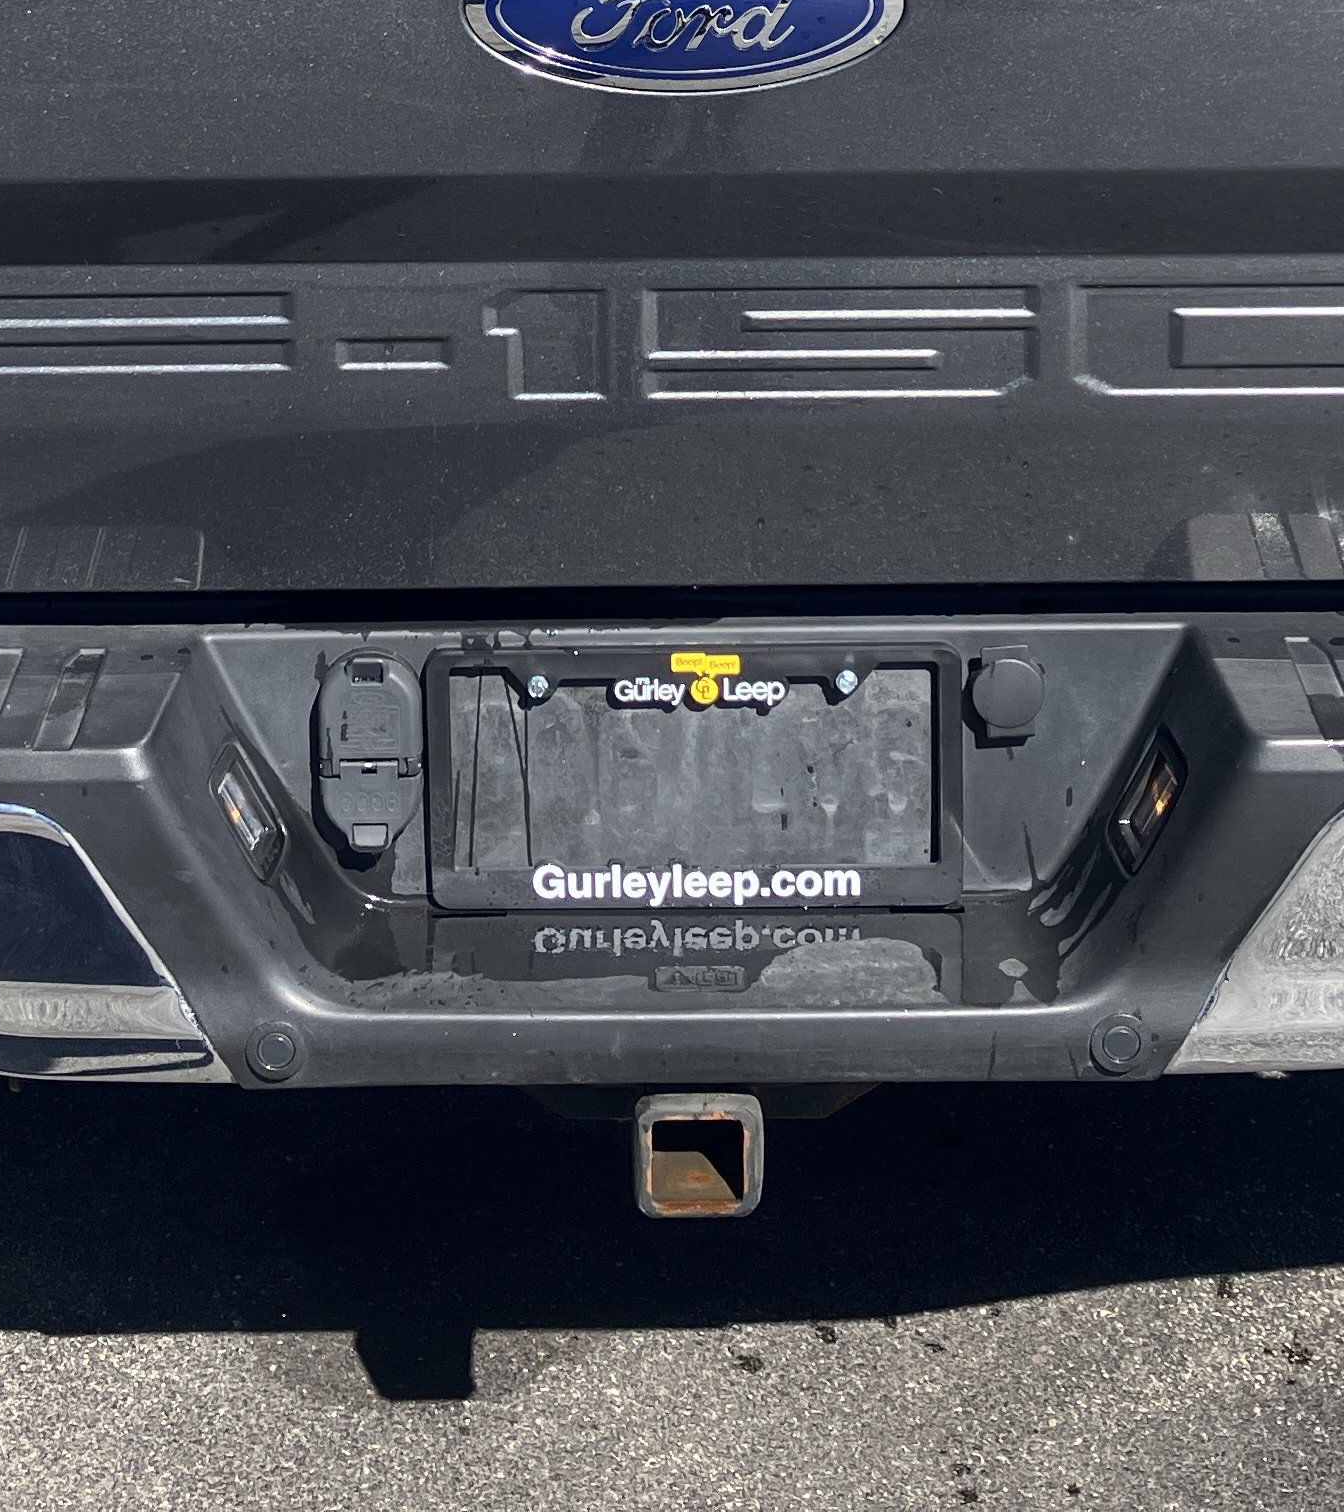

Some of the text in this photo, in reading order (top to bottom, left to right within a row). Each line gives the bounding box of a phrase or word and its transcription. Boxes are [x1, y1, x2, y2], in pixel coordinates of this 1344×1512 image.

[676, 657, 736, 671] Beep! Beep!
[614, 678, 685, 706] Gurley
[723, 677, 786, 706] Leep
[532, 862, 862, 907] Gurleyleep.com
